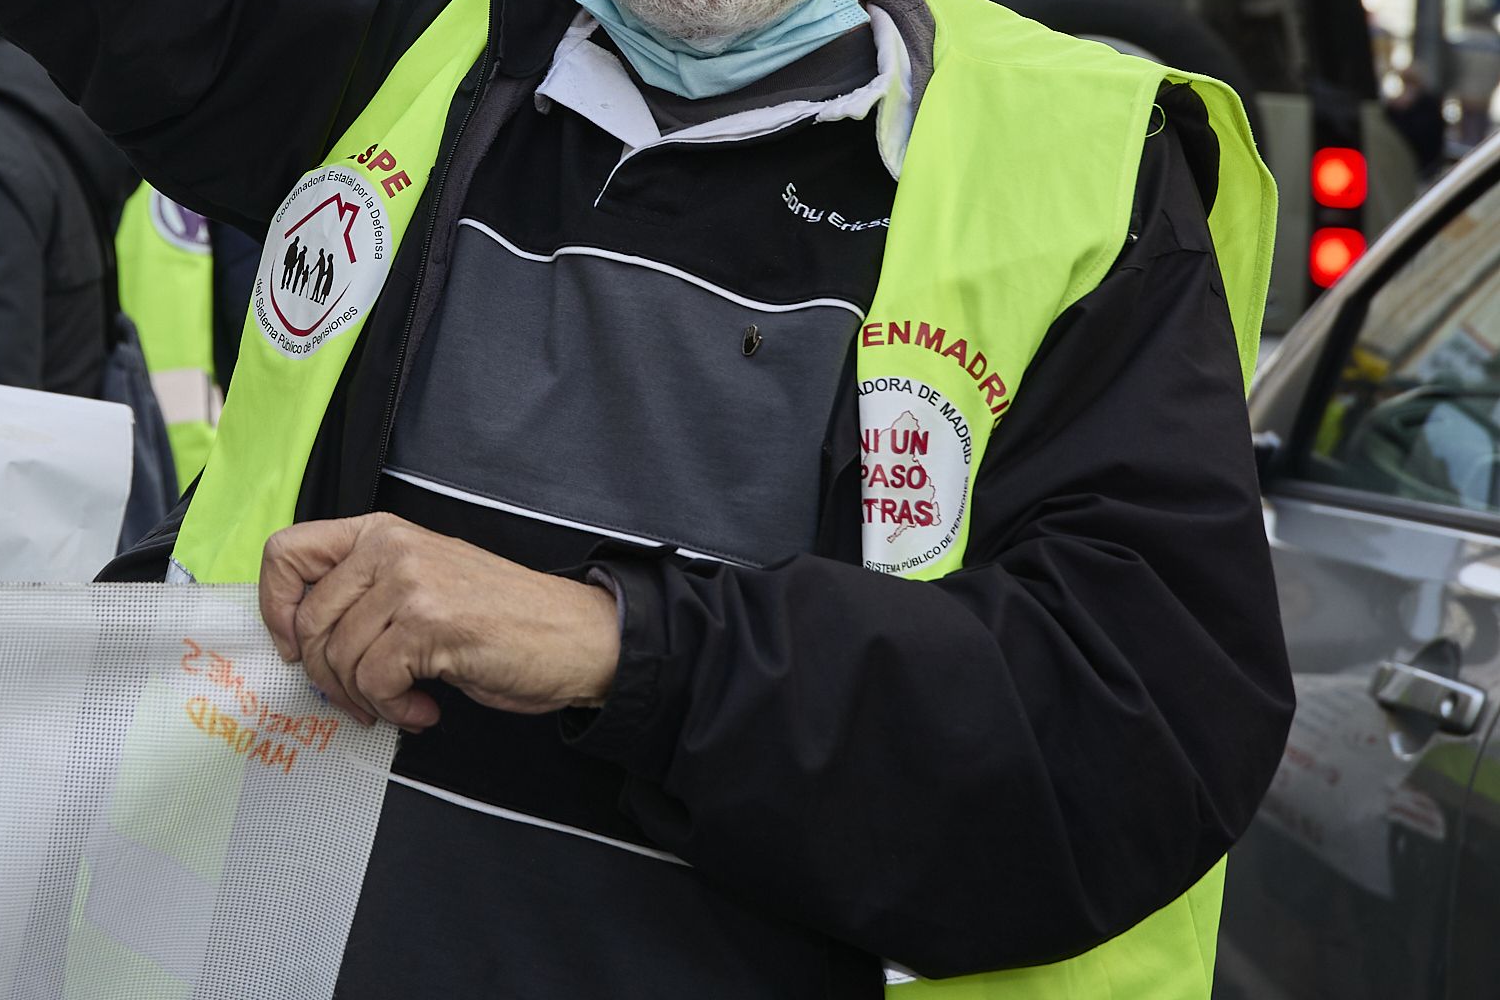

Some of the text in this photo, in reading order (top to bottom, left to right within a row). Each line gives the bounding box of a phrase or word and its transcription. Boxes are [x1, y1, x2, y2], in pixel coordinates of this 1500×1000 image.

[347, 144, 412, 199] SPE
[276, 170, 385, 260] Coordinadora Estatal por la Defensa
[781, 182, 825, 223] Sony
[256, 297, 279, 341] Sistema
[277, 333, 303, 354] Público
[303, 341, 312, 354] de
[312, 306, 358, 349] Pensiones
[862, 320, 1010, 434] ENMADRI
[890, 429, 930, 455] UN
[918, 385, 941, 407] DE
[940, 402, 972, 465] MADRID
[862, 498, 934, 528] TRAS
[864, 560, 901, 573] SISTEMA
[901, 546, 942, 571] PÚBLICO
[940, 534, 954, 549] DE
